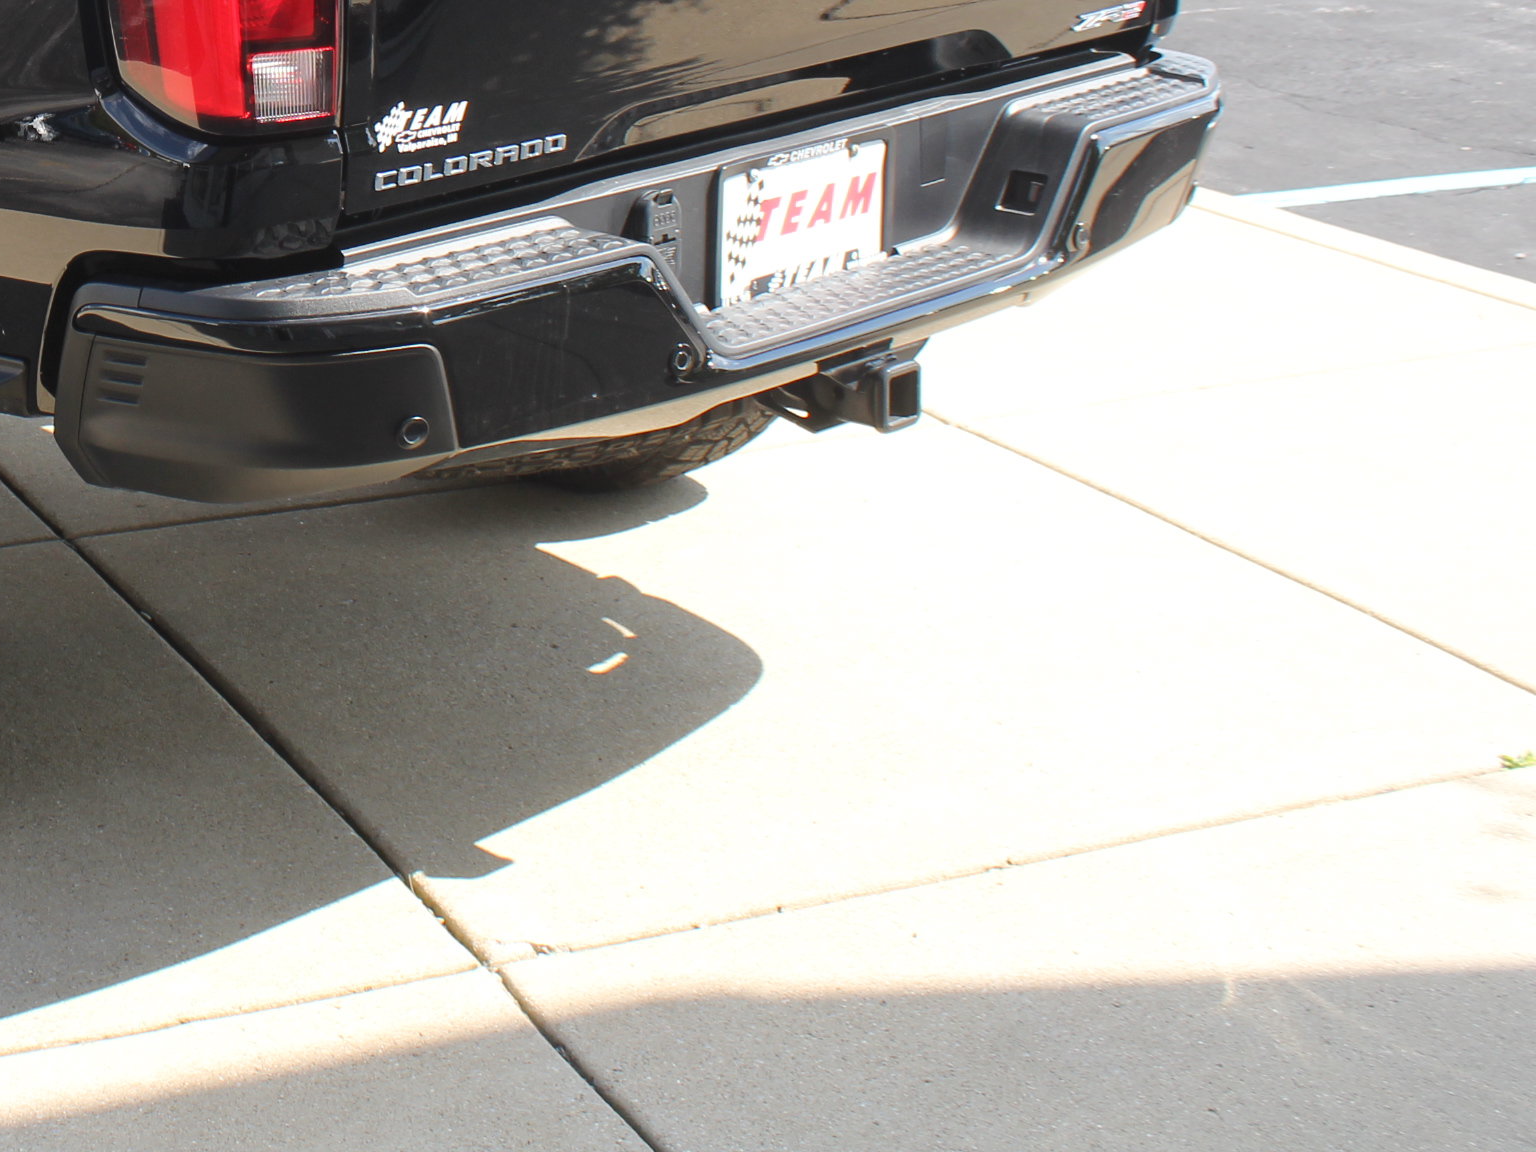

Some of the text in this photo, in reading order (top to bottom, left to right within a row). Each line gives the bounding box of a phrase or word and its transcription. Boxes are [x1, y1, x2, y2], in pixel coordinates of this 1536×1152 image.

[1073, 0, 1147, 32] ZR2
[397, 100, 470, 132] TEAM
[417, 122, 461, 138] CHEVROLET
[375, 133, 567, 191] COLORADO
[790, 138, 849, 162] CHEVROLET
[754, 171, 878, 243] TEAM
